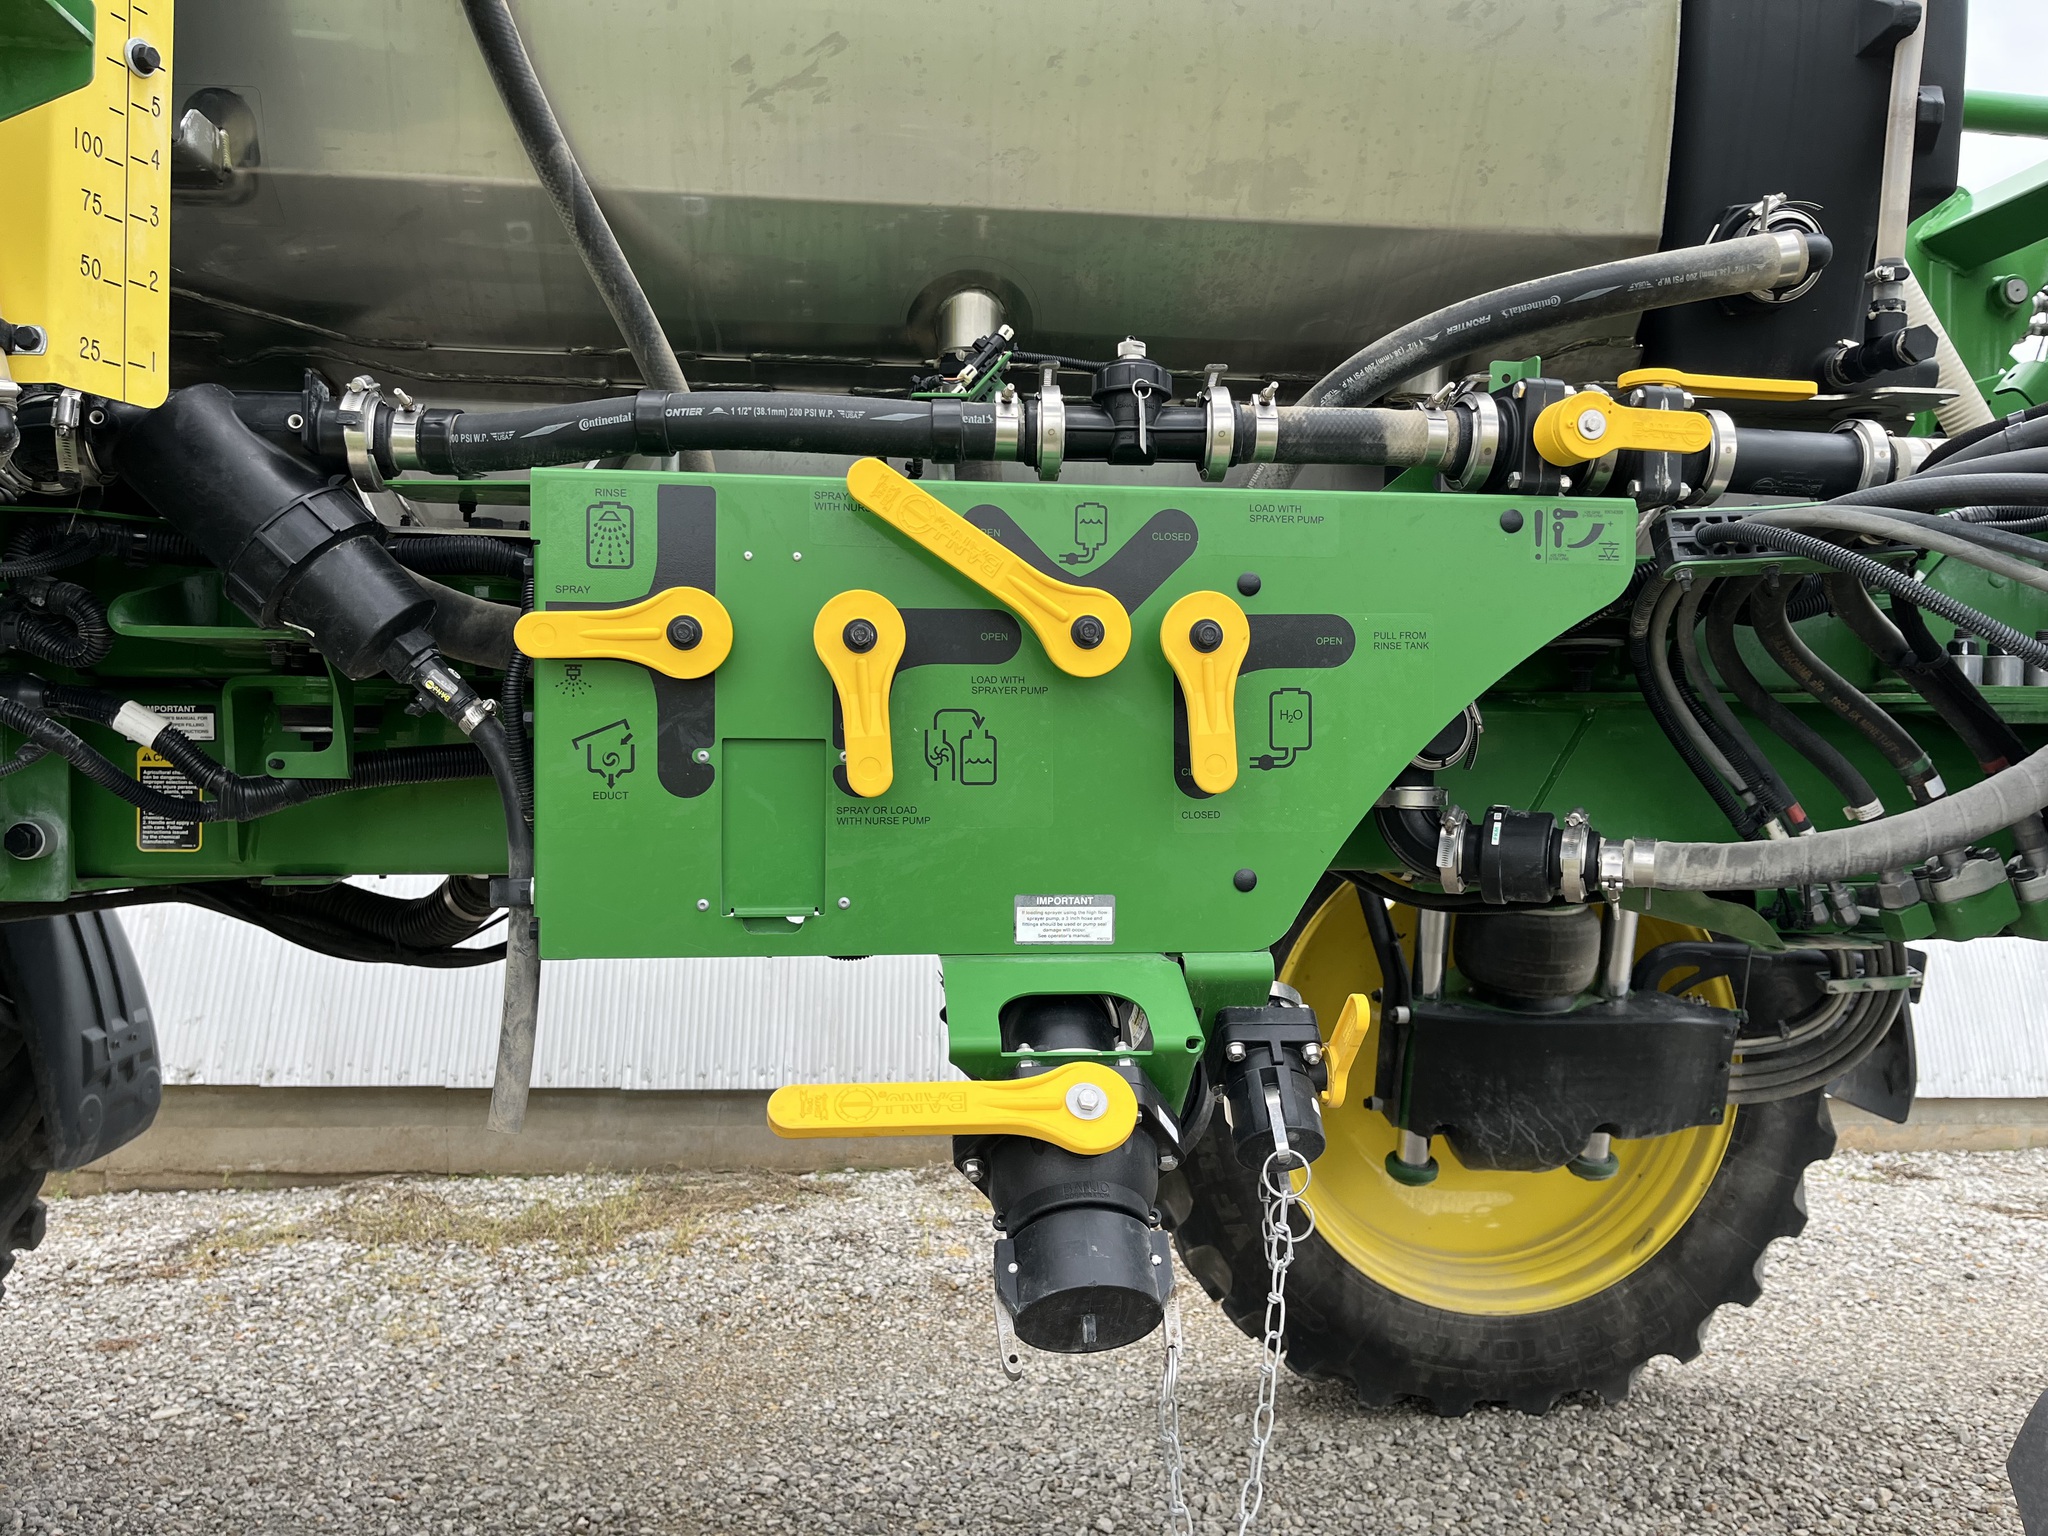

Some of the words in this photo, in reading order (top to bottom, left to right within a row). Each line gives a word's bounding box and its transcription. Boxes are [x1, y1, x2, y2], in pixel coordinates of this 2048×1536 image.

[151, 96, 161, 118] 5
[75, 127, 103, 158] 100
[151, 149, 160, 171] 4
[81, 188, 102, 216] 75
[150, 205, 159, 227] 3
[80, 254, 101, 280] 50
[149, 270, 159, 292] 2
[1672, 274, 1685, 284] PSI
[1686, 272, 1699, 281] 200
[1509, 295, 1561, 317] Continental
[1446, 314, 1491, 336] FRONTIER
[80, 336, 100, 362] 25
[1364, 361, 1376, 375] 200
[1352, 366, 1366, 381] PSI
[665, 407, 703, 417] ONTIER
[730, 407, 735, 416] 1
[753, 407, 788, 418] (38.1mm)
[789, 408, 802, 417] 200
[804, 408, 817, 417] PSI
[818, 409, 836, 418] W.P.
[578, 411, 632, 431] Continental
[460, 433, 473, 443] PSI
[473, 433, 489, 443] W.P.
[595, 488, 627, 497] RINSE
[814, 491, 849, 501] SPRAY
[814, 502, 841, 511] WITH
[843, 503, 871, 513] NUR
[1249, 504, 1276, 513] LOAD
[1278, 504, 1302, 513] WITH
[1249, 514, 1295, 524] SPRAYER
[1297, 515, 1325, 524] PUMP
[1151, 532, 1192, 541] CLOSED
[555, 585, 591, 594] SPRAY
[980, 632, 1008, 641] OPEN
[1373, 631, 1397, 640] PULL
[1399, 631, 1427, 640] FROM
[1315, 636, 1343, 646] OPEN
[1373, 641, 1402, 650] RINSE
[1404, 641, 1430, 650] TANK
[971, 675, 998, 684] LOAD
[1000, 675, 1025, 684] WITH
[971, 686, 1018, 695] SPRAYER
[1020, 686, 1049, 695] PUMP
[1829, 695, 1851, 713] tech
[592, 791, 629, 800] EDUCT
[835, 806, 871, 815] SPRAY
[873, 806, 889, 815] OR
[890, 805, 918, 815] LOAD
[1181, 810, 1221, 819] CLOSED
[836, 816, 862, 826] WITH
[864, 816, 900, 826] NURSE
[902, 816, 931, 825] PUMP
[1036, 896, 1094, 905] IMPORTANT
